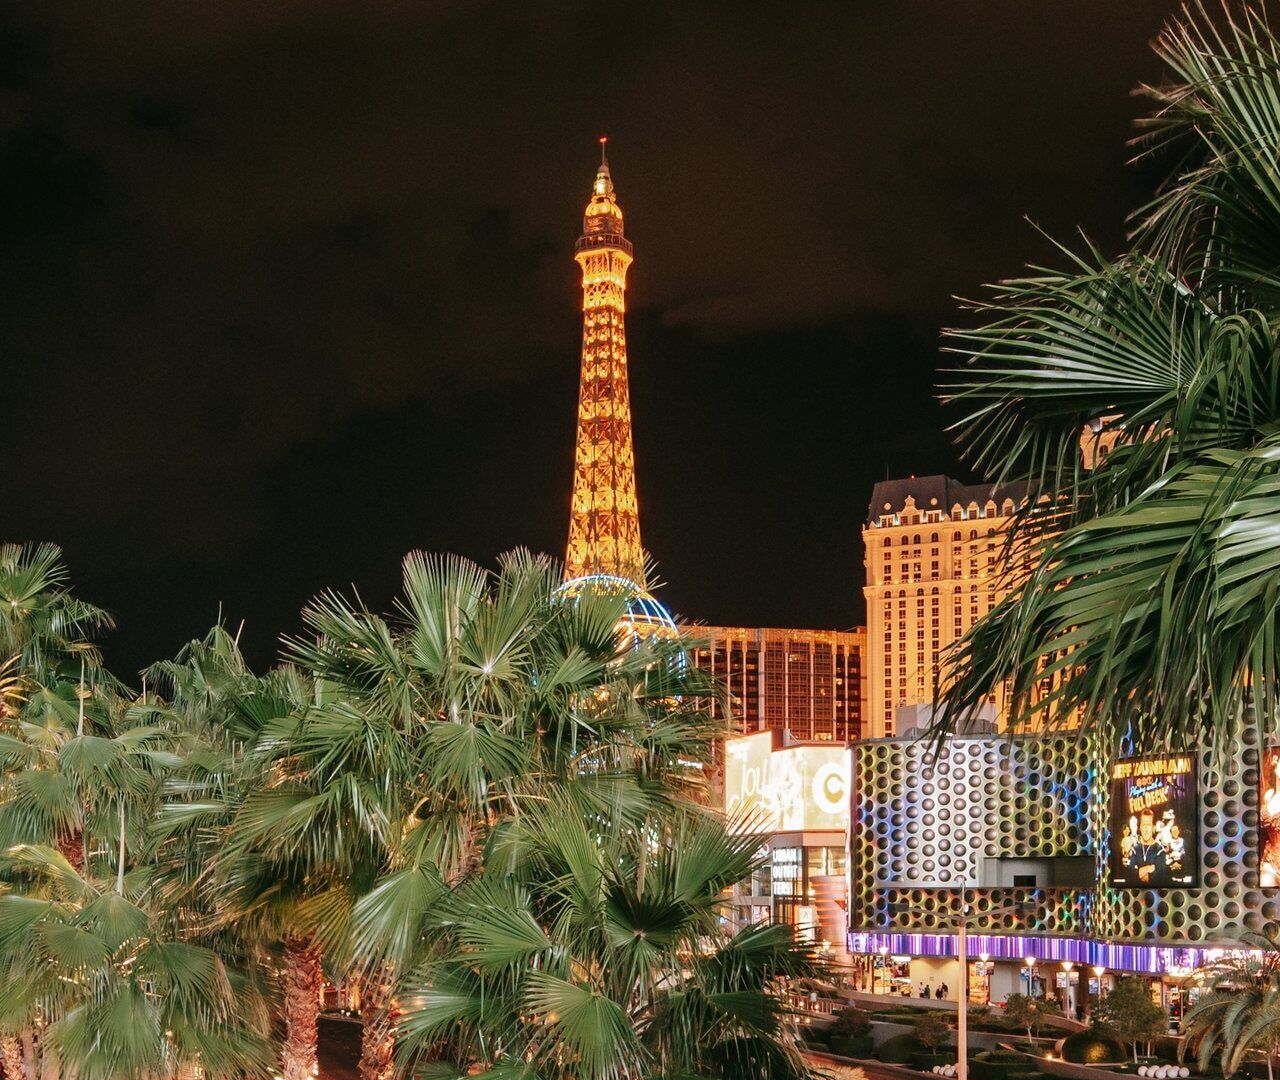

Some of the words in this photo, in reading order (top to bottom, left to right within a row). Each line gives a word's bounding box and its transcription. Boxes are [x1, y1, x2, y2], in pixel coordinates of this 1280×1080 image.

[1112, 763, 1132, 779] JEFF
[1133, 758, 1191, 776] DUNHAM
[1145, 787, 1168, 807] DECK
[772, 848, 797, 862] URBAN
[772, 865, 799, 879] OUTFIT
